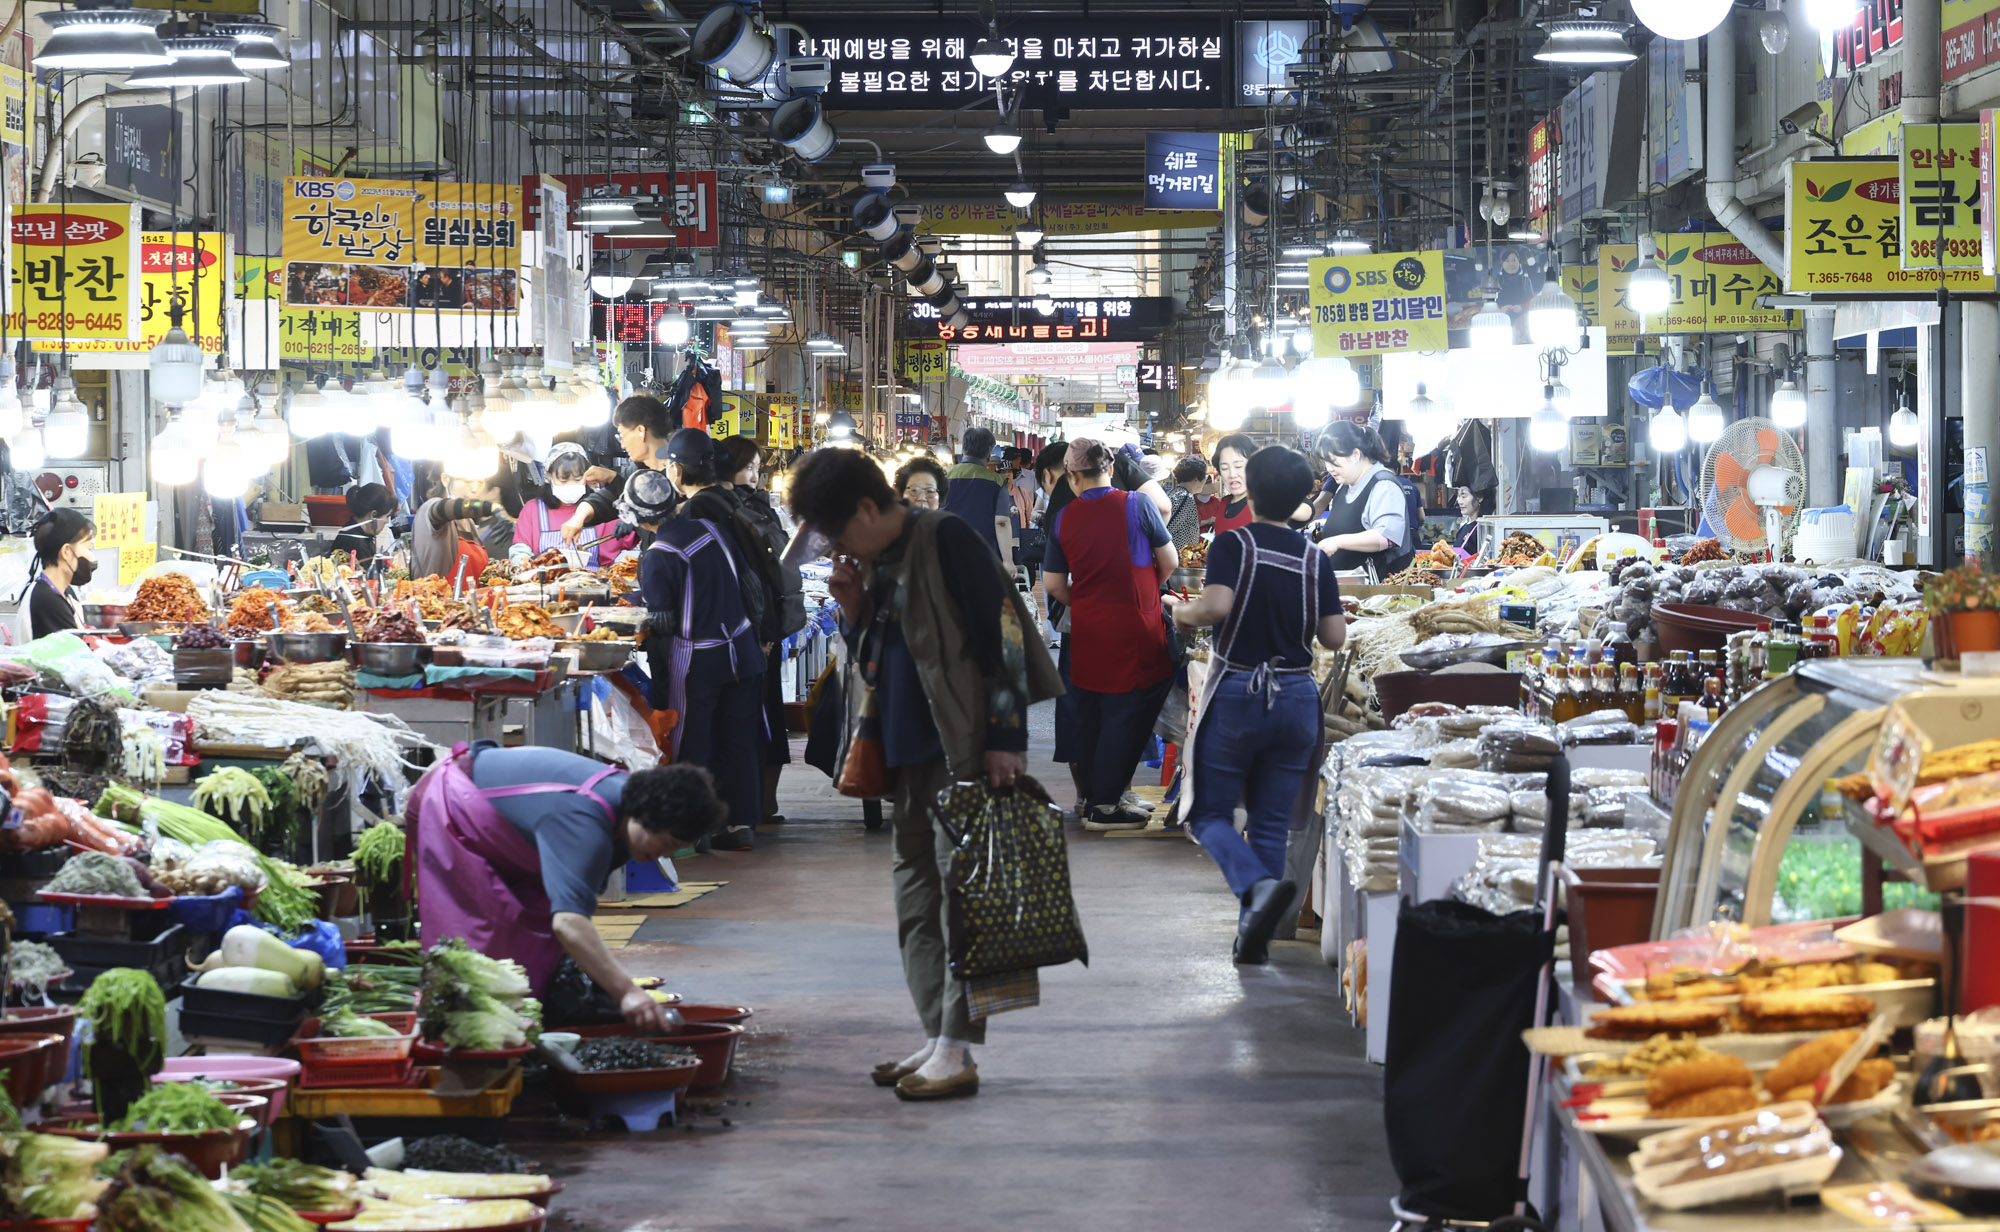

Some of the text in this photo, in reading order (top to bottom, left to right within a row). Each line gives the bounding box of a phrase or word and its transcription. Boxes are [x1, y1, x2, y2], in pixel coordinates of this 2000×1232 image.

[921, 38, 965, 59] 위해
[1054, 37, 1121, 59] 마치고
[1131, 37, 1221, 58] 귀가하실
[840, 71, 930, 92] 불필요한
[1089, 70, 1211, 91] 차단합시다.
[1164, 151, 1198, 170] 쉐프
[294, 181, 336, 199] KBS
[1148, 174, 1214, 194] 먹거리길
[12, 221, 109, 240] 모님 손맛
[292, 201, 398, 247] 한국인의
[424, 216, 516, 248] 일심상회
[338, 229, 416, 262] 밥상
[1355, 270, 1388, 286] SBS
[1807, 271, 1980, 284] T.365-7648 010-8709-7715
[1103, 301, 1132, 317] 위한
[1315, 296, 1443, 323] 785회 방영 김치달인
[1339, 329, 1409, 351] 하남반찬
[894, 352, 944, 376] 평상회
